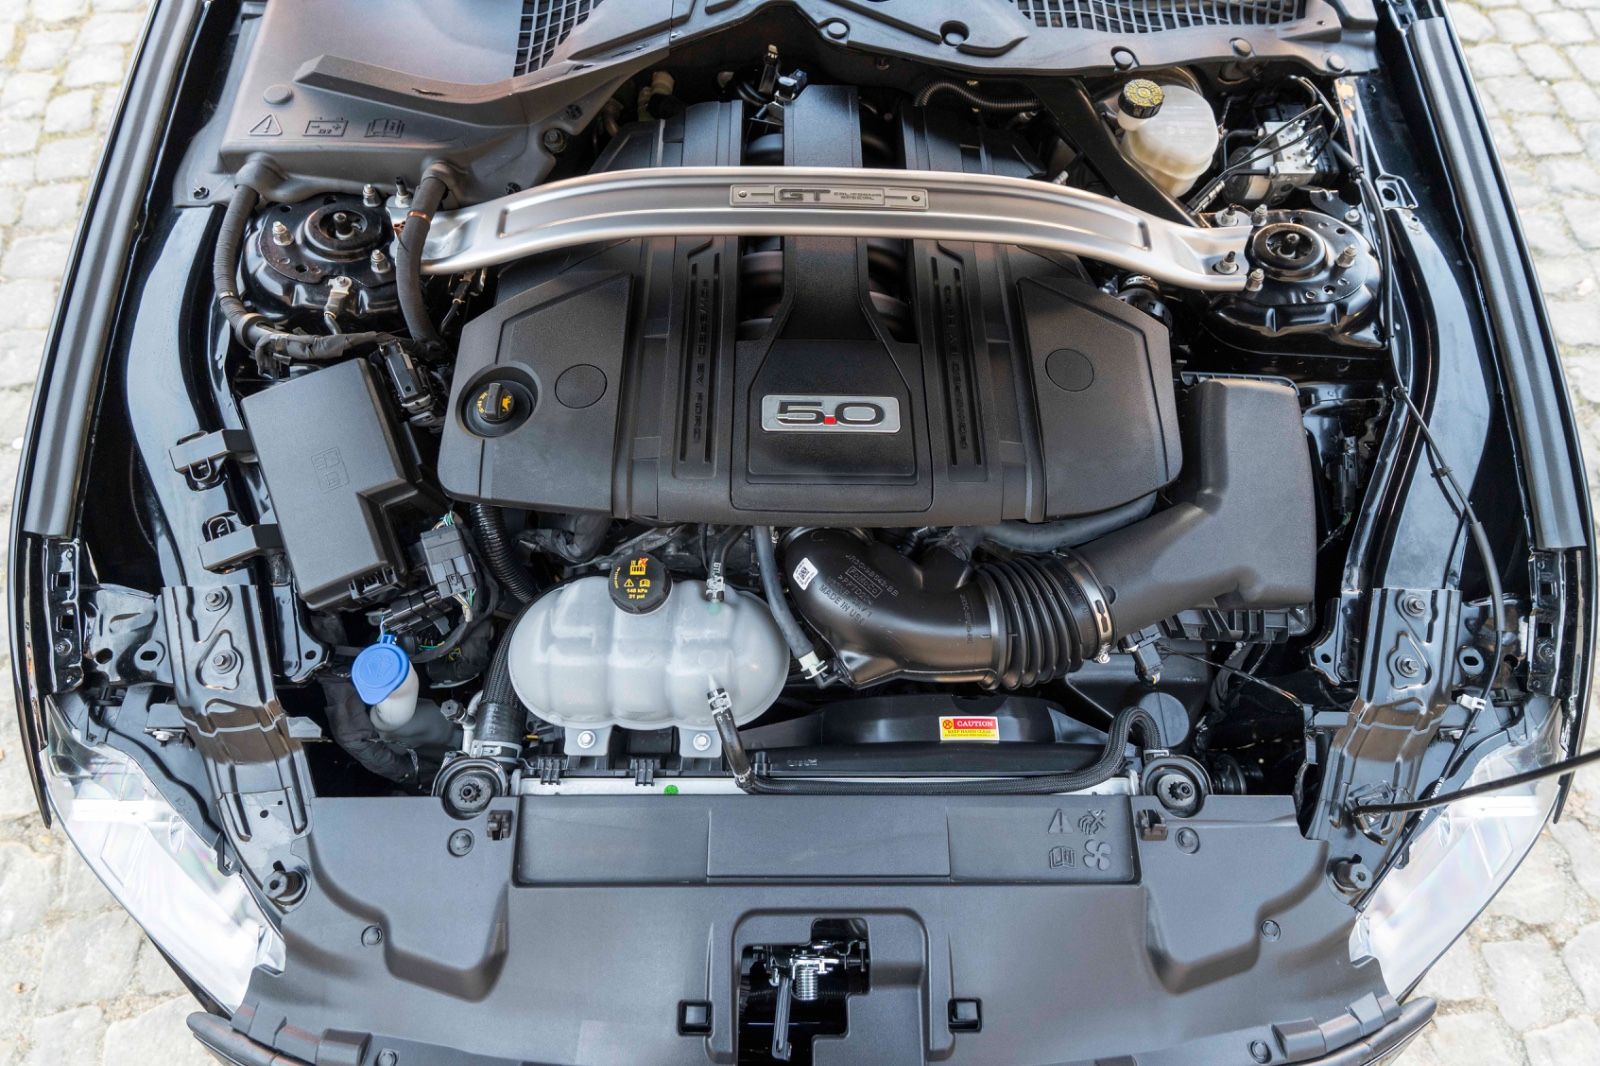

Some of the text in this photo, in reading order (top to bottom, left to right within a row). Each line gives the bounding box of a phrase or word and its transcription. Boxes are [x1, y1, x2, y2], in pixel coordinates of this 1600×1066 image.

[779, 189, 830, 201] GT
[776, 401, 886, 426] 5.0
[819, 583, 842, 605] MADE
[840, 601, 851, 612] IN
